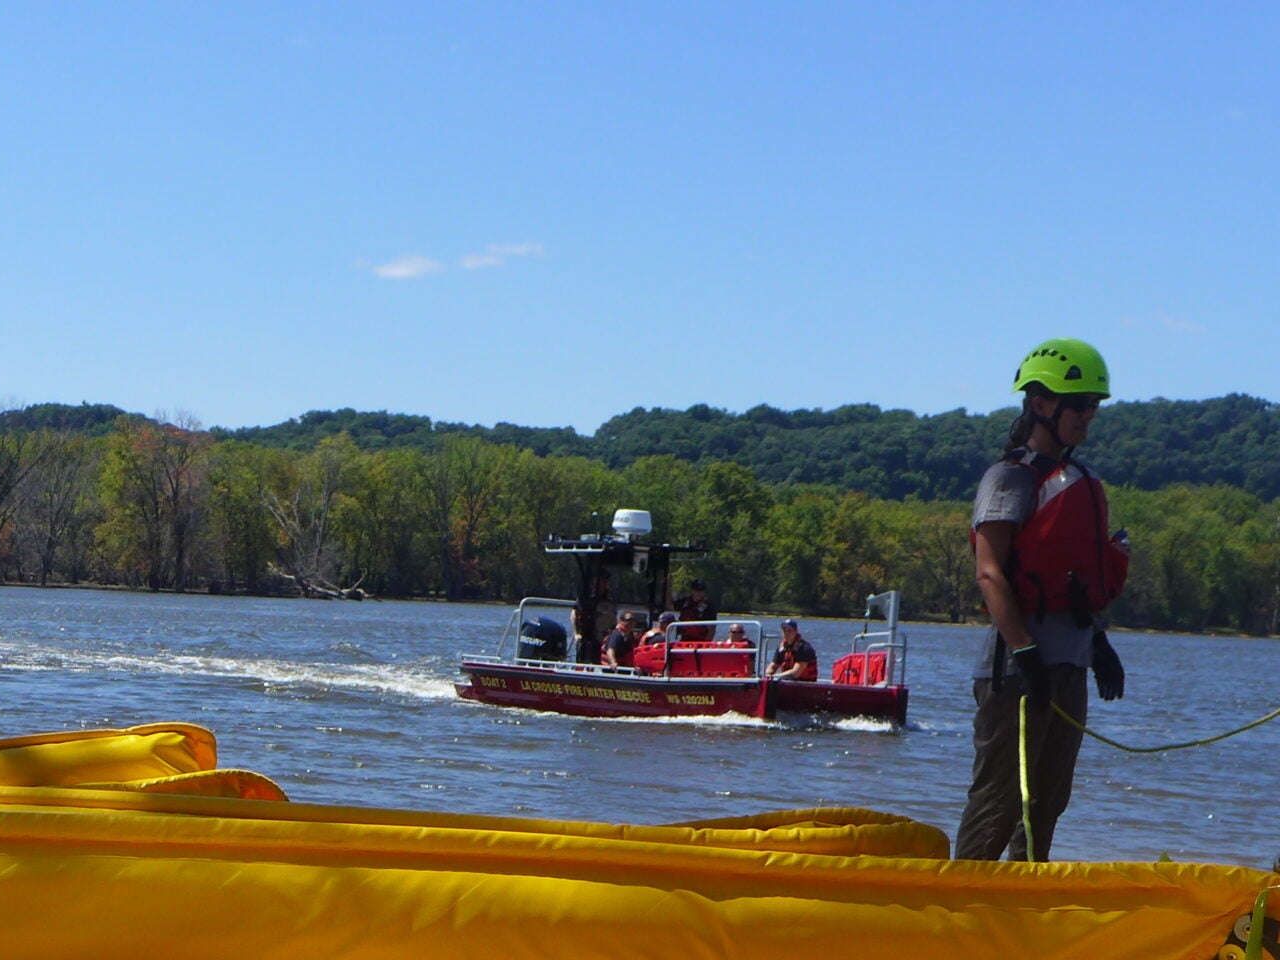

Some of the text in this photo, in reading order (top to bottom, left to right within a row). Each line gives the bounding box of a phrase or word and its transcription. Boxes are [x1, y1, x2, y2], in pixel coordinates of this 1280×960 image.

[480, 676, 507, 689] BOAT 2
[520, 680, 531, 691] LA
[531, 681, 563, 695] CROSSE
[615, 689, 652, 704] RESCUE
[665, 694, 680, 704] WS
